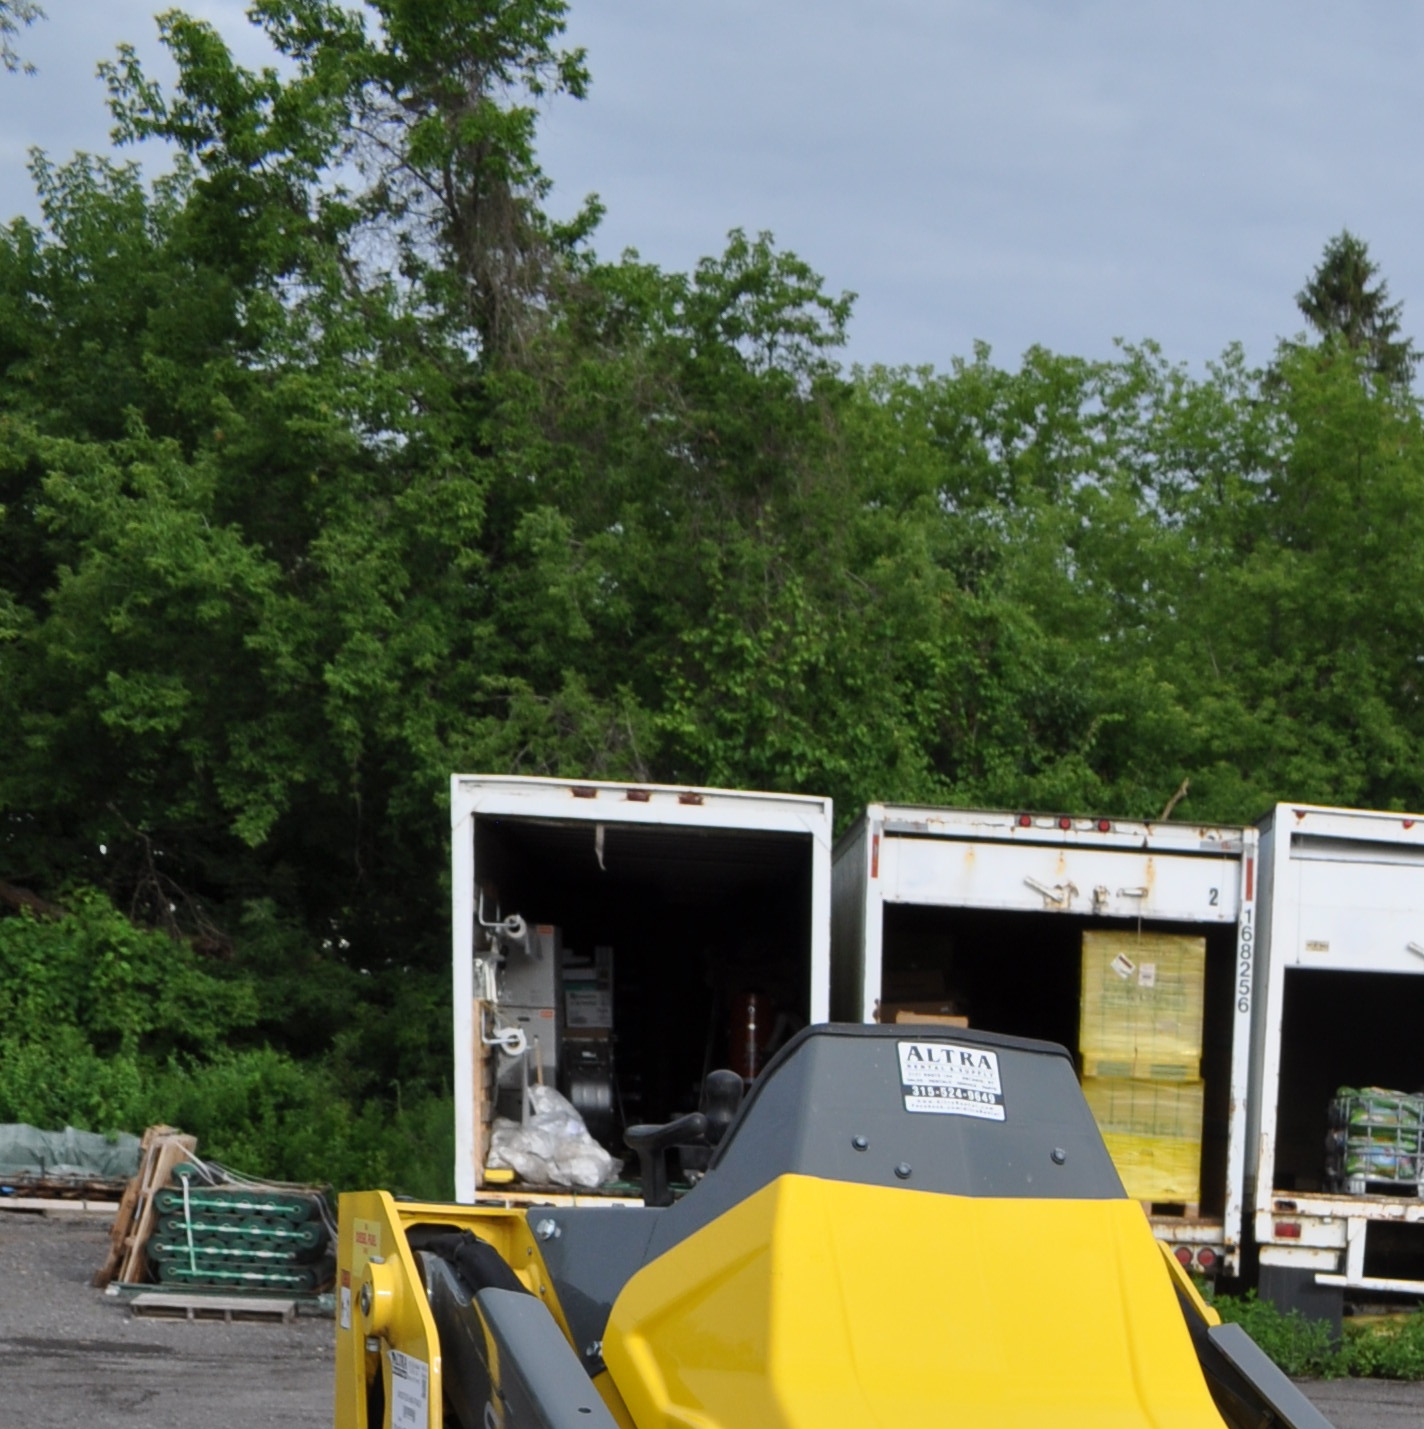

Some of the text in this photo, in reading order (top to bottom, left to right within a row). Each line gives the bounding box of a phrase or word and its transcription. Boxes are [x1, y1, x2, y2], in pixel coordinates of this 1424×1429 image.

[1208, 887, 1219, 907] 2
[1237, 908, 1253, 1014] 168256
[907, 1045, 992, 1070] ALTRA
